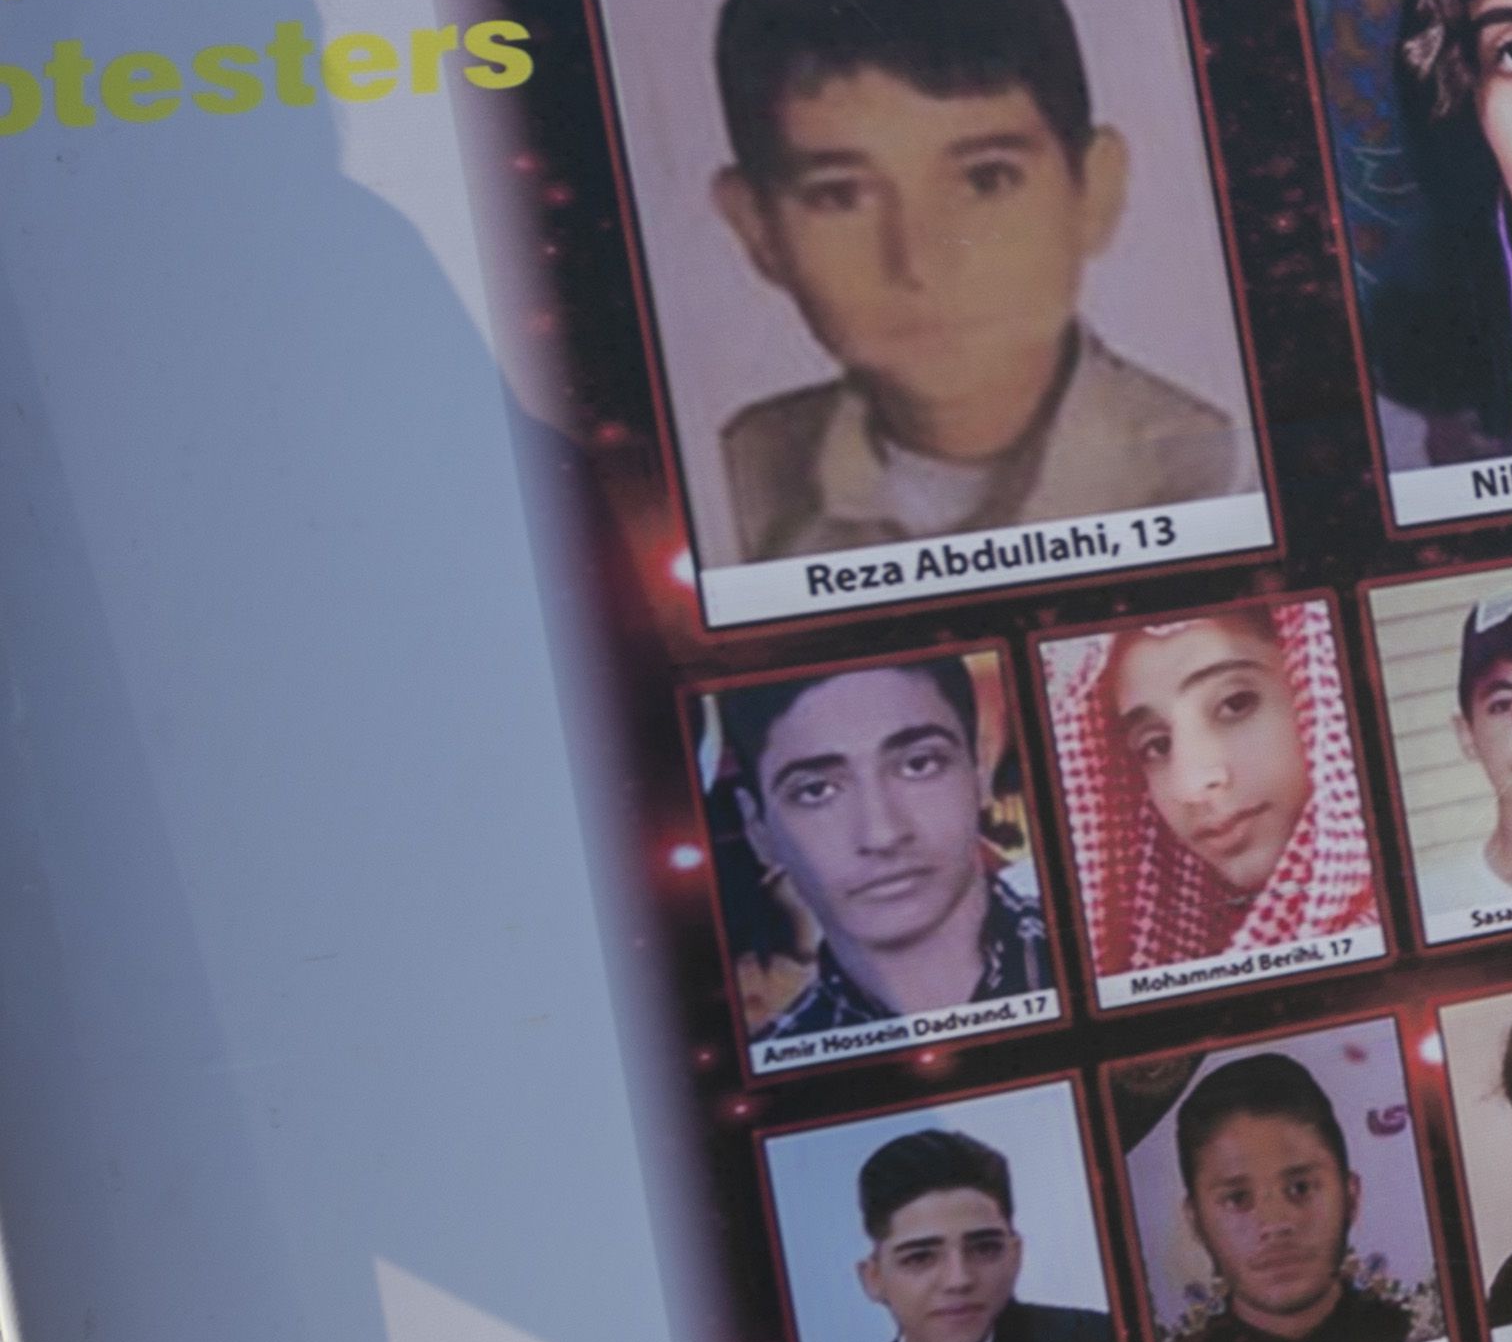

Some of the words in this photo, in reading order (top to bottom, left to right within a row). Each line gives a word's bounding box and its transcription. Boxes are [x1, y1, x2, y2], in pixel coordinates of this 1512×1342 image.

[0, 20, 534, 137] otesters
[804, 555, 905, 599] Reza
[914, 521, 1121, 585] Abdullahi,
[1130, 515, 1177, 550] 13
[1131, 959, 1254, 995] Mohammad
[1328, 939, 1354, 959] 17
[762, 1038, 816, 1065] Amir
[820, 1023, 910, 1056] Hossein
[913, 1003, 1018, 1040] Dadvand,
[1021, 995, 1048, 1017] 17
